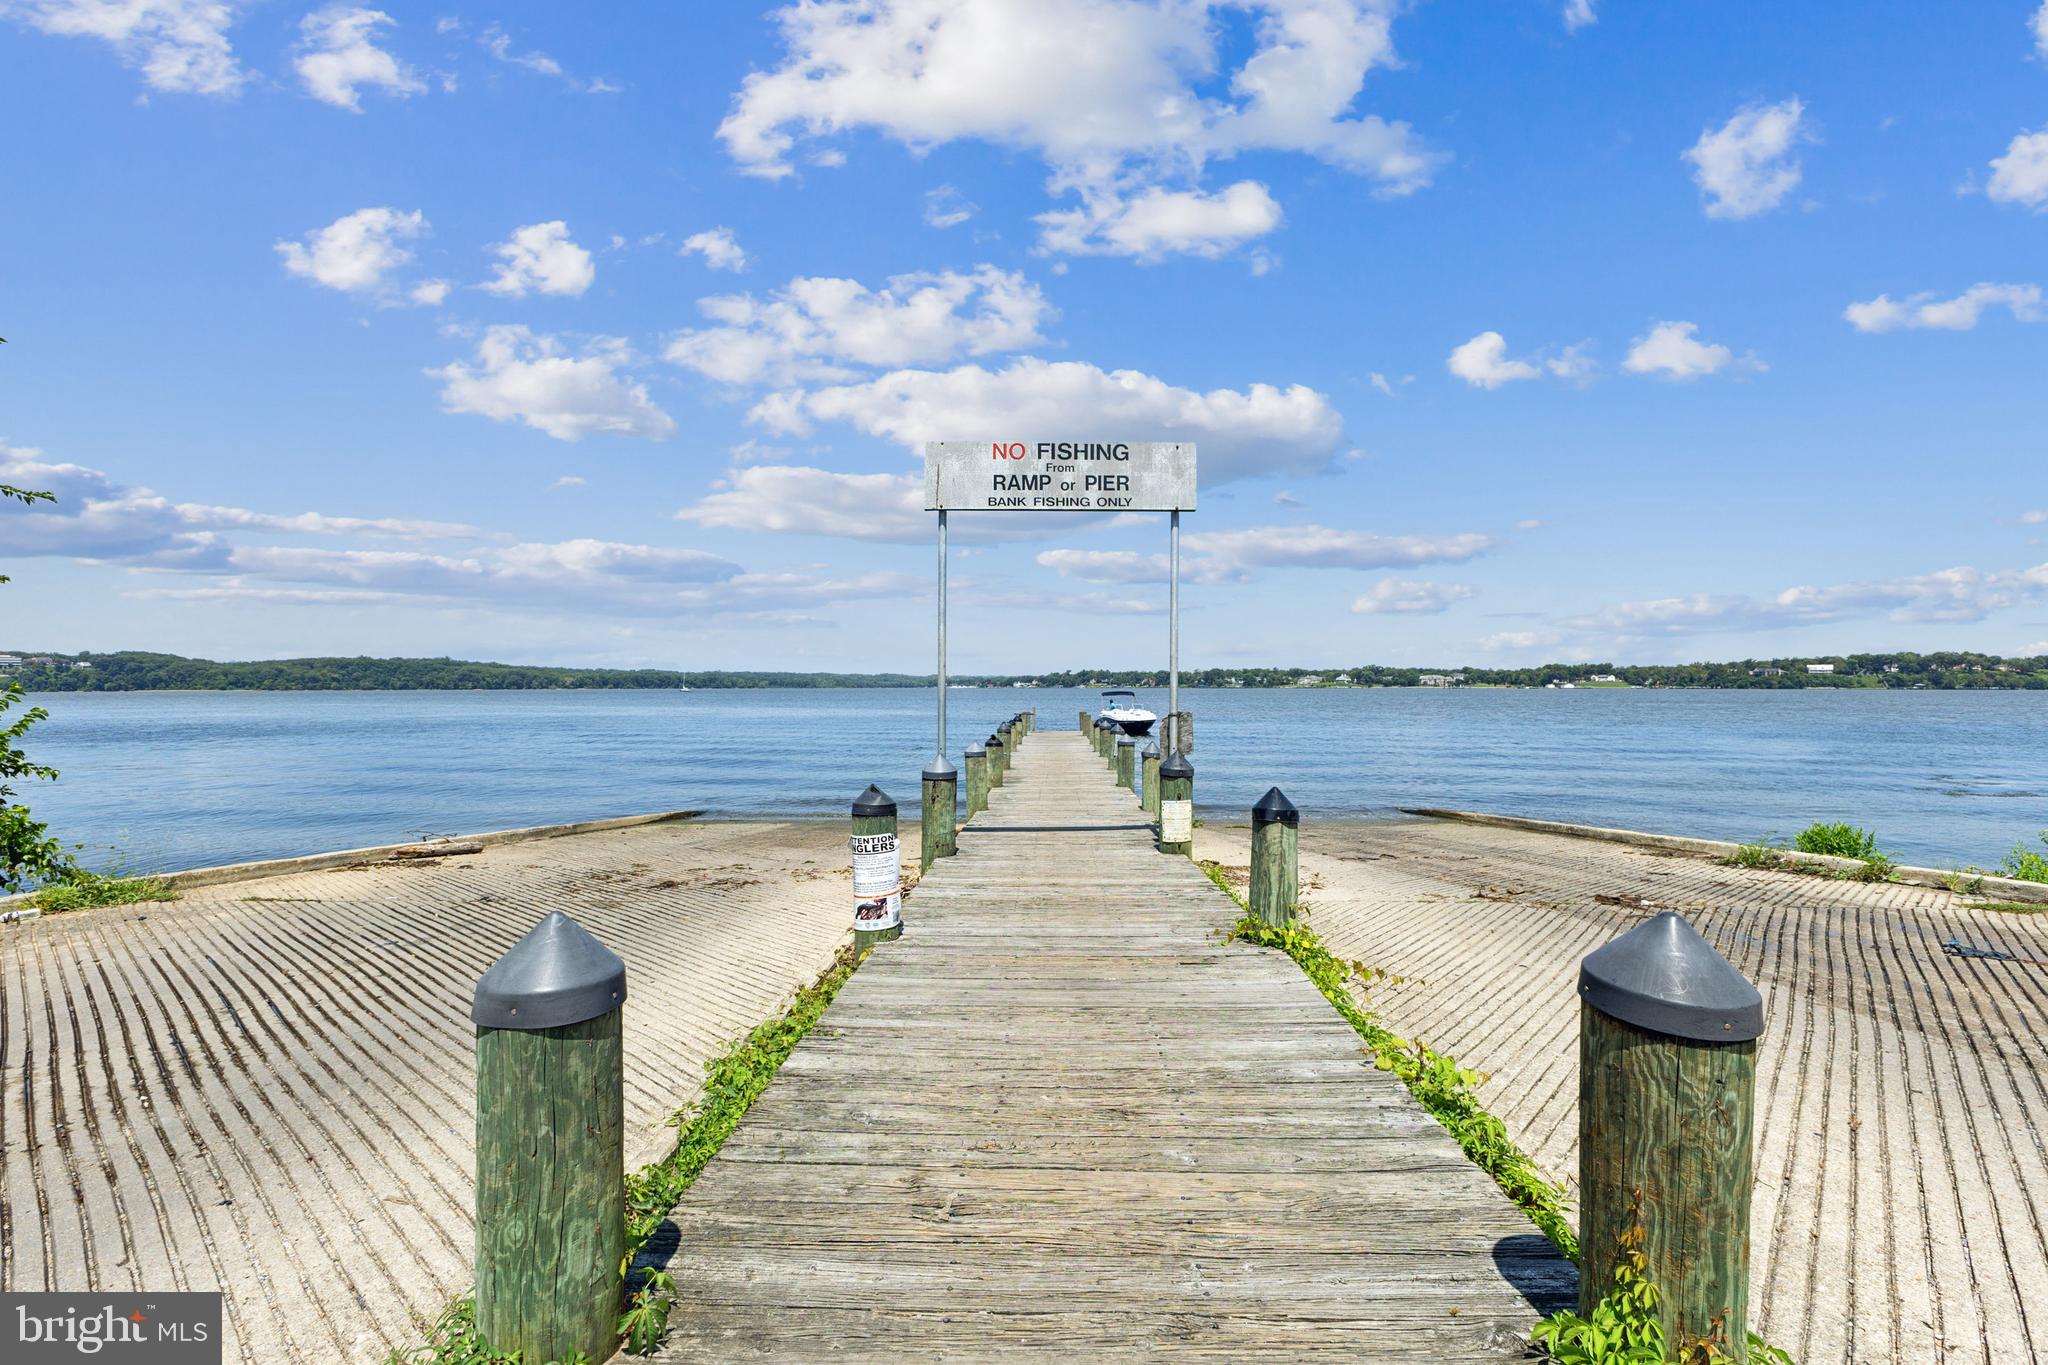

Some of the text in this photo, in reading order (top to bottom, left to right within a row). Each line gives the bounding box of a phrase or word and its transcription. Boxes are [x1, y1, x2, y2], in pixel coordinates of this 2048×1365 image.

[993, 443, 1129, 461] NO FISHING
[1046, 463, 1075, 472] From
[993, 475, 1130, 491] RAMP or PIER
[988, 497, 1132, 507] BANK FISHING ONLY
